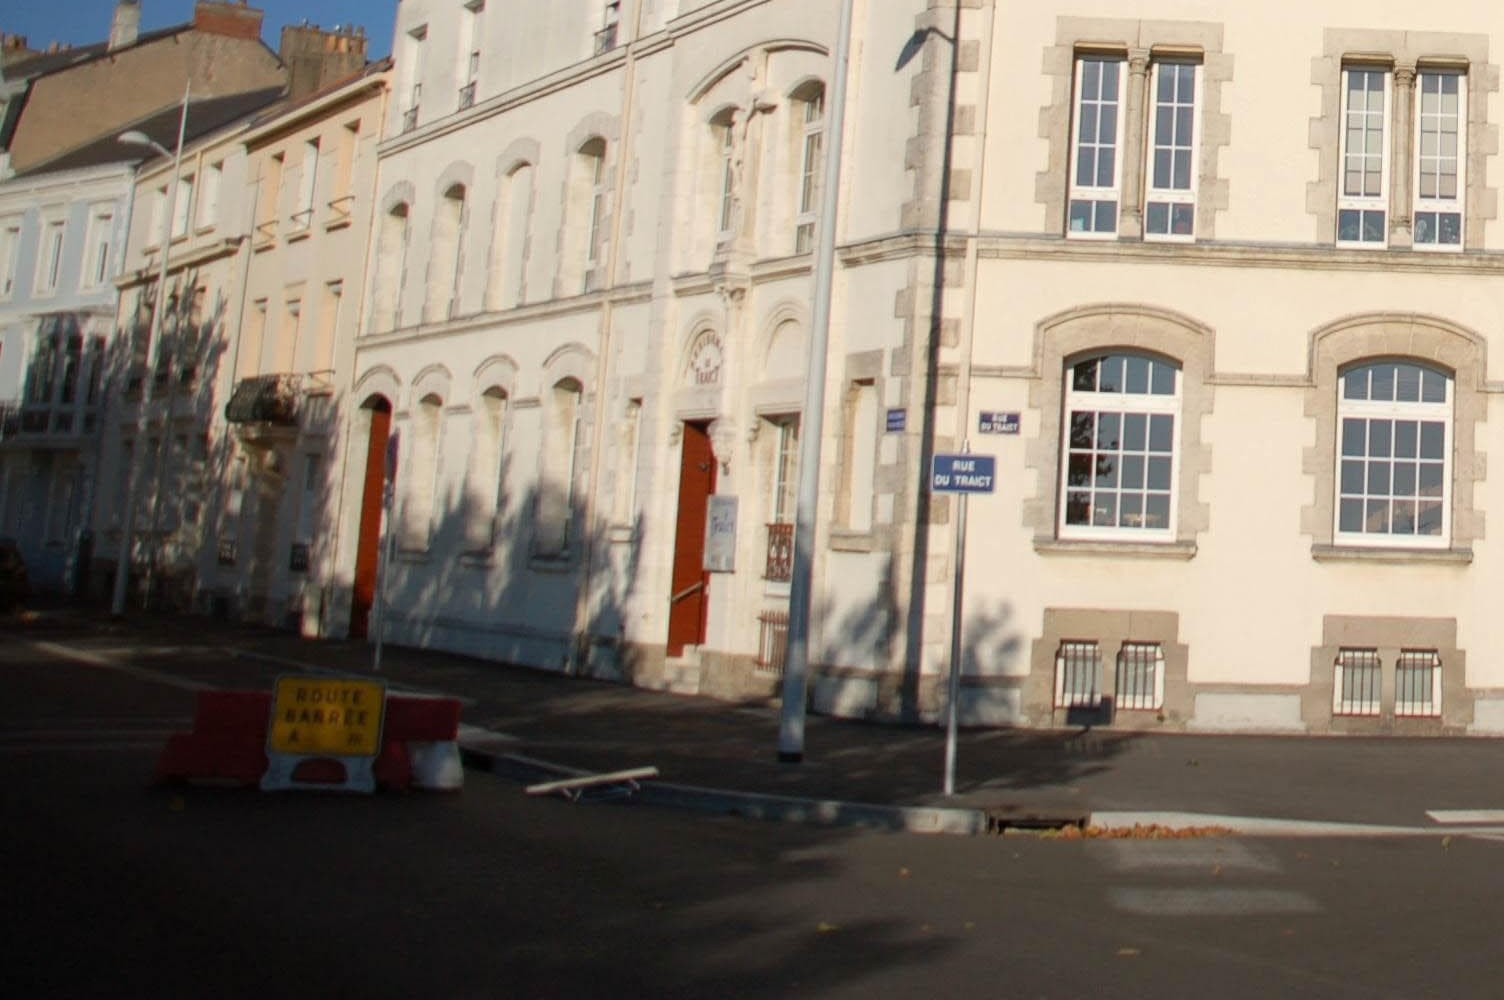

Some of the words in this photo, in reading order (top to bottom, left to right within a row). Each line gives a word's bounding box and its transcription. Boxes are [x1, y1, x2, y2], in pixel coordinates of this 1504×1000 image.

[992, 414, 1007, 422] RUE
[981, 422, 991, 431] DU
[993, 422, 1018, 431] TRAICT
[952, 460, 975, 471] RUE
[934, 475, 950, 486] DU
[955, 475, 992, 487] TRAICT
[296, 687, 364, 704] ROUTE
